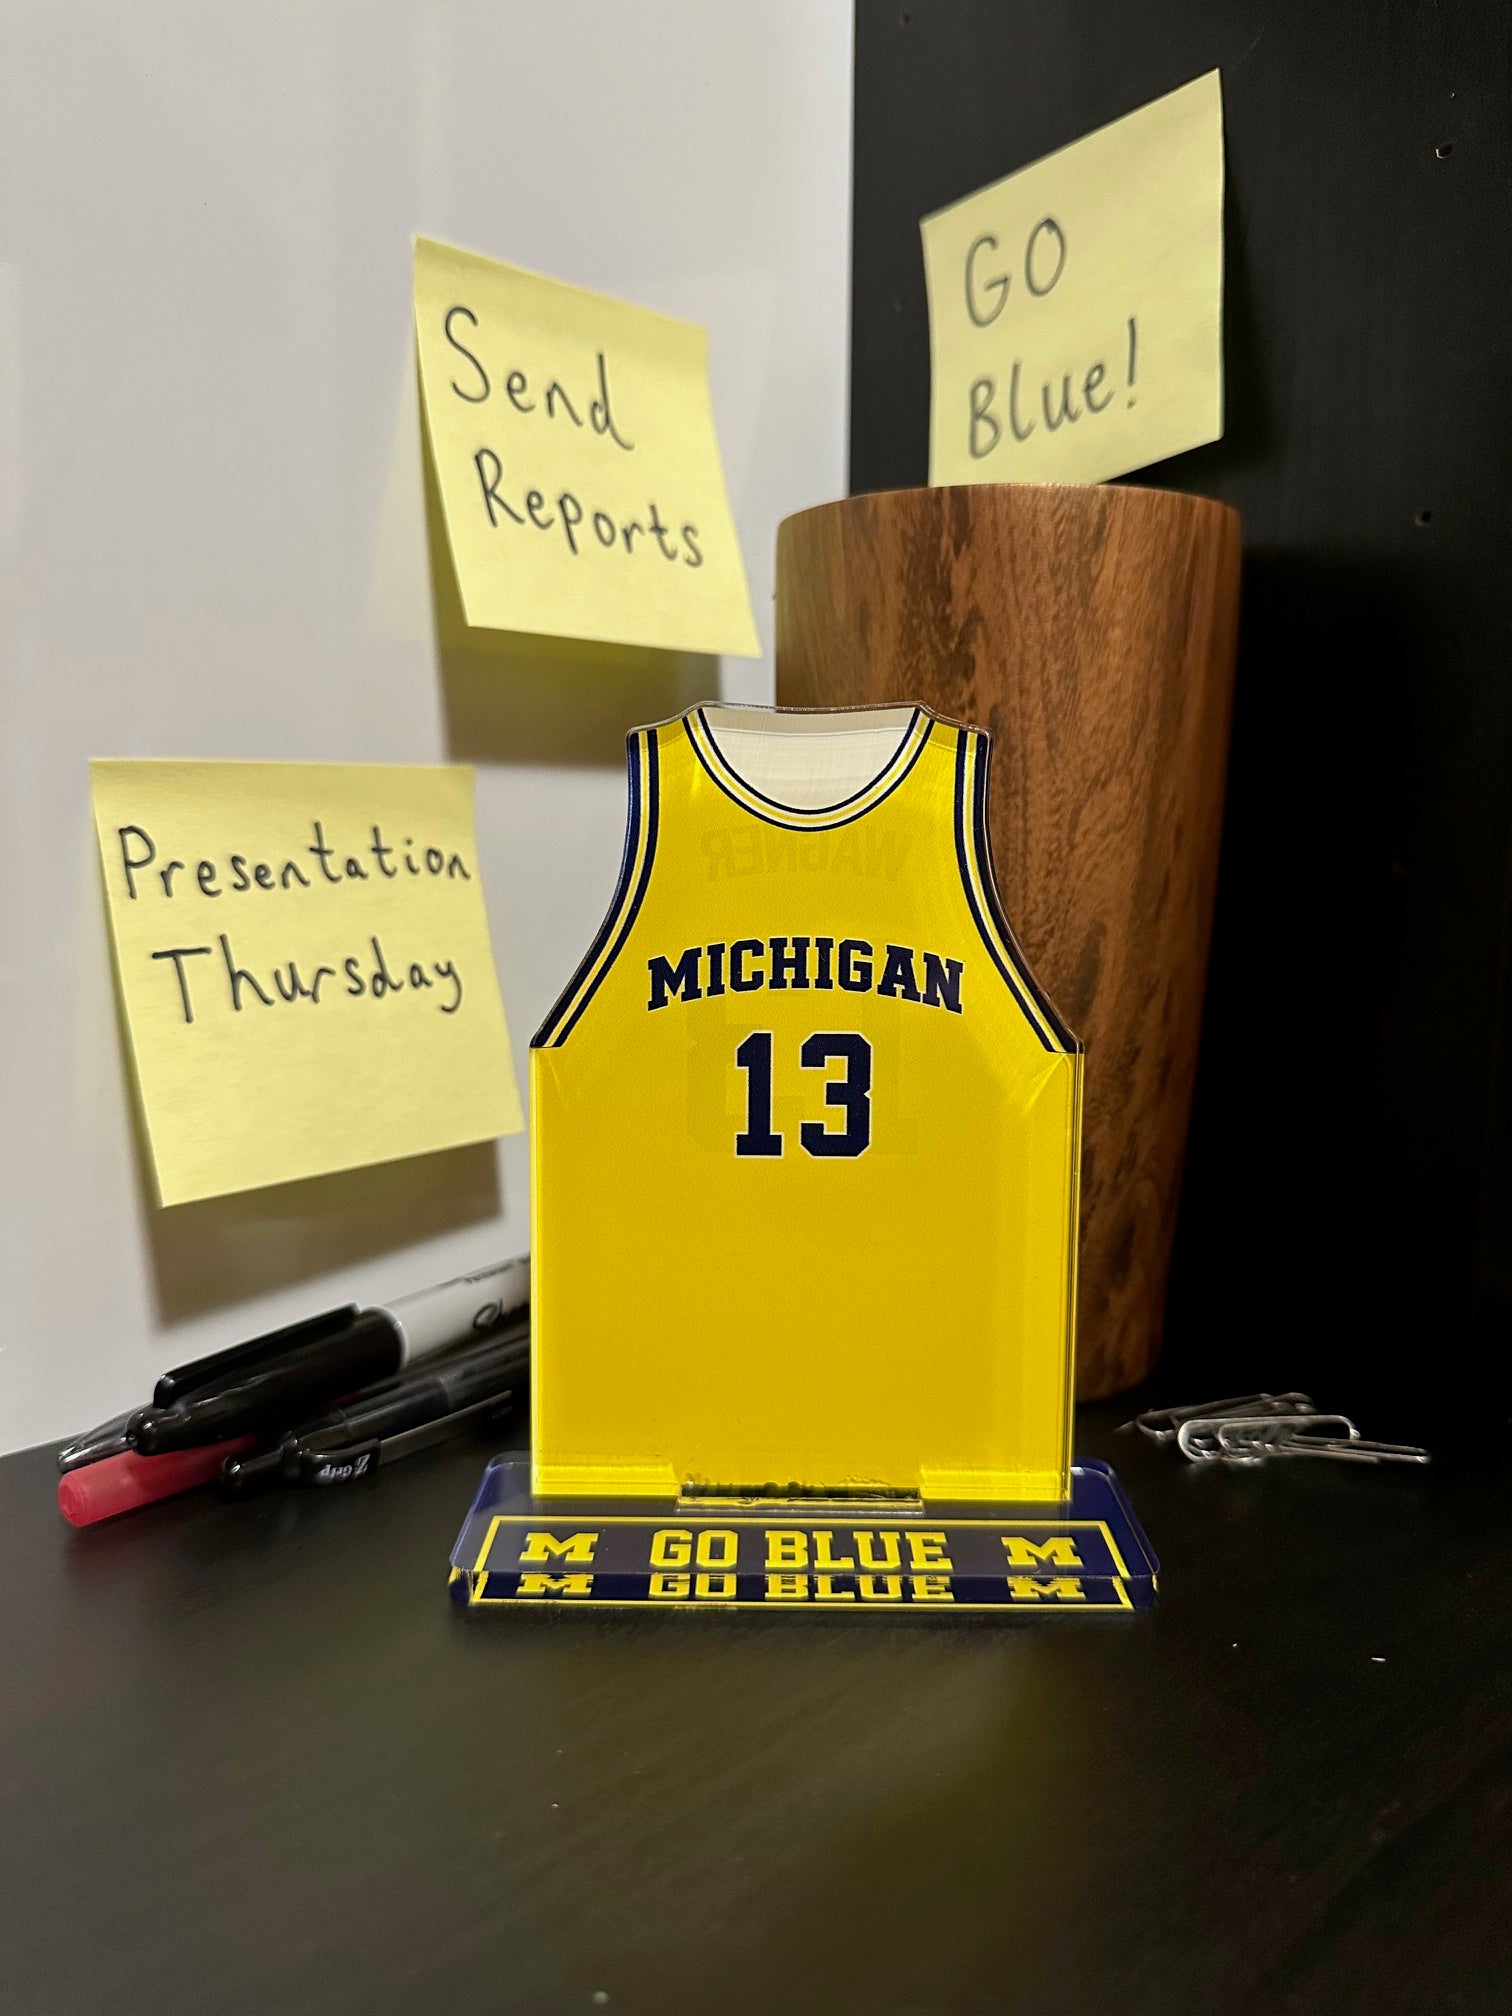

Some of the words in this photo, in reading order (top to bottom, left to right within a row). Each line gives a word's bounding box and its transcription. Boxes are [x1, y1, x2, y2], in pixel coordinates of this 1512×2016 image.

[965, 217, 1066, 328] GO
[445, 305, 635, 451] Send
[969, 317, 1137, 460] Blue!
[474, 448, 703, 568] Reports
[118, 821, 472, 900] Presentation
[151, 933, 464, 1024] Thursday
[647, 935, 965, 1015] MICHIGAN
[734, 1029, 873, 1160] 13
[519, 1531, 599, 1562] M
[650, 1529, 738, 1568] GO
[764, 1530, 954, 1569] BLUE
[1001, 1536, 1084, 1567] M
